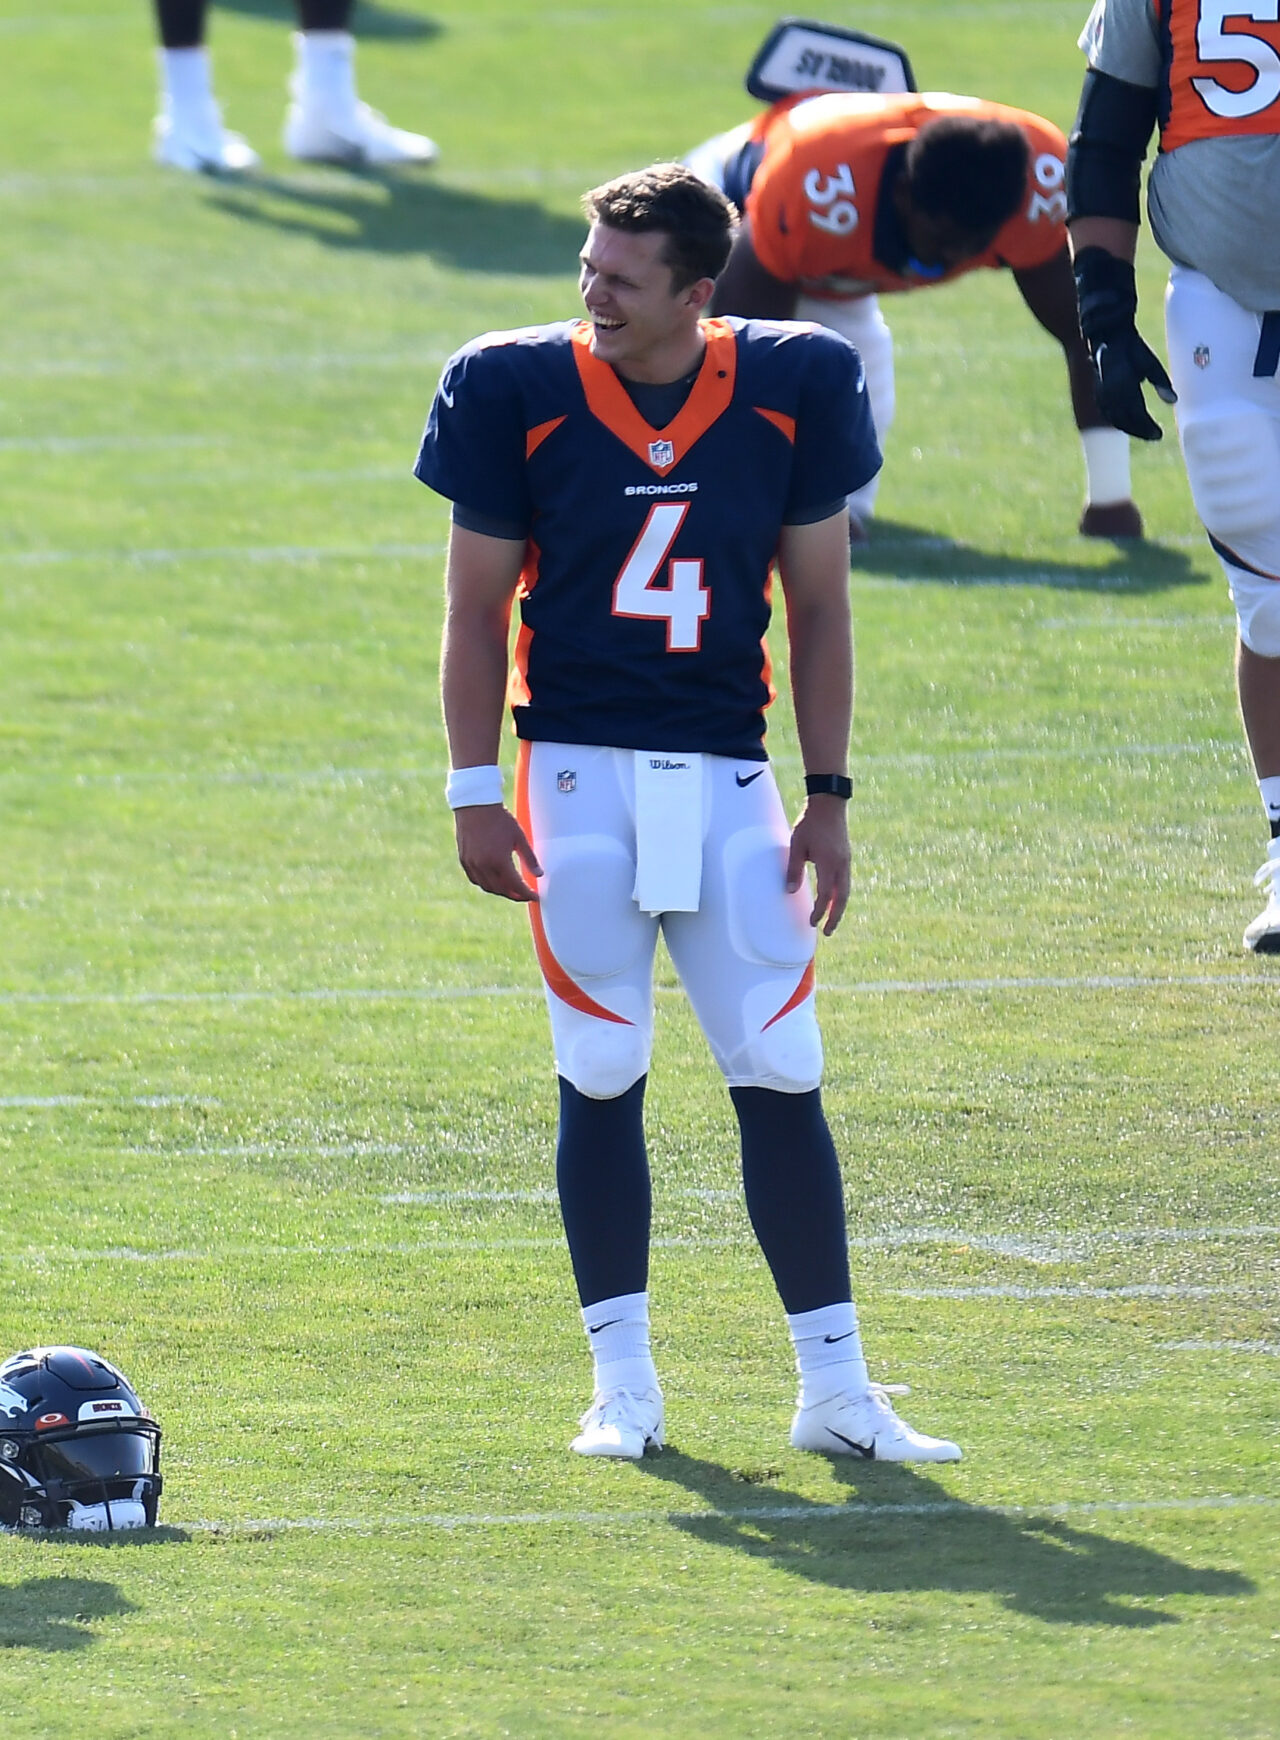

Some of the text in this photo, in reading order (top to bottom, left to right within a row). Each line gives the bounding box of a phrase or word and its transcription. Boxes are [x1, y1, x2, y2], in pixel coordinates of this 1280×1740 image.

[803, 163, 860, 237] 39
[624, 482, 699, 496] BRONCOS
[611, 501, 712, 653] 4
[649, 759, 691, 770] Wilson
